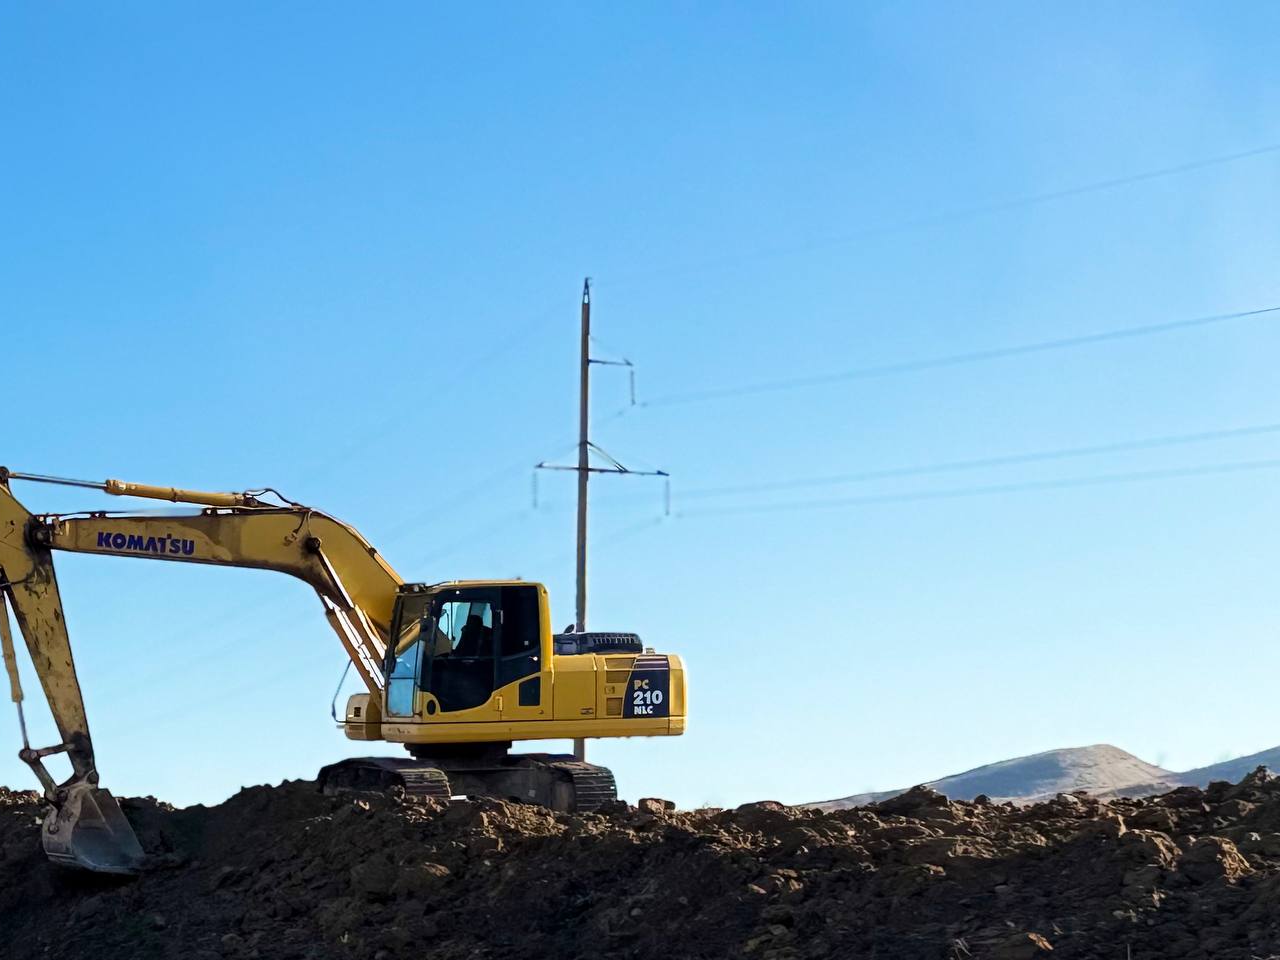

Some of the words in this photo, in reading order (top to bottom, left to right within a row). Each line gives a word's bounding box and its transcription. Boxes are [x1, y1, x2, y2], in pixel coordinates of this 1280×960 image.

[97, 532, 195, 555] KOMATSU
[633, 679, 649, 690] PC
[633, 690, 663, 705] 210
[633, 705, 654, 715] NLC
